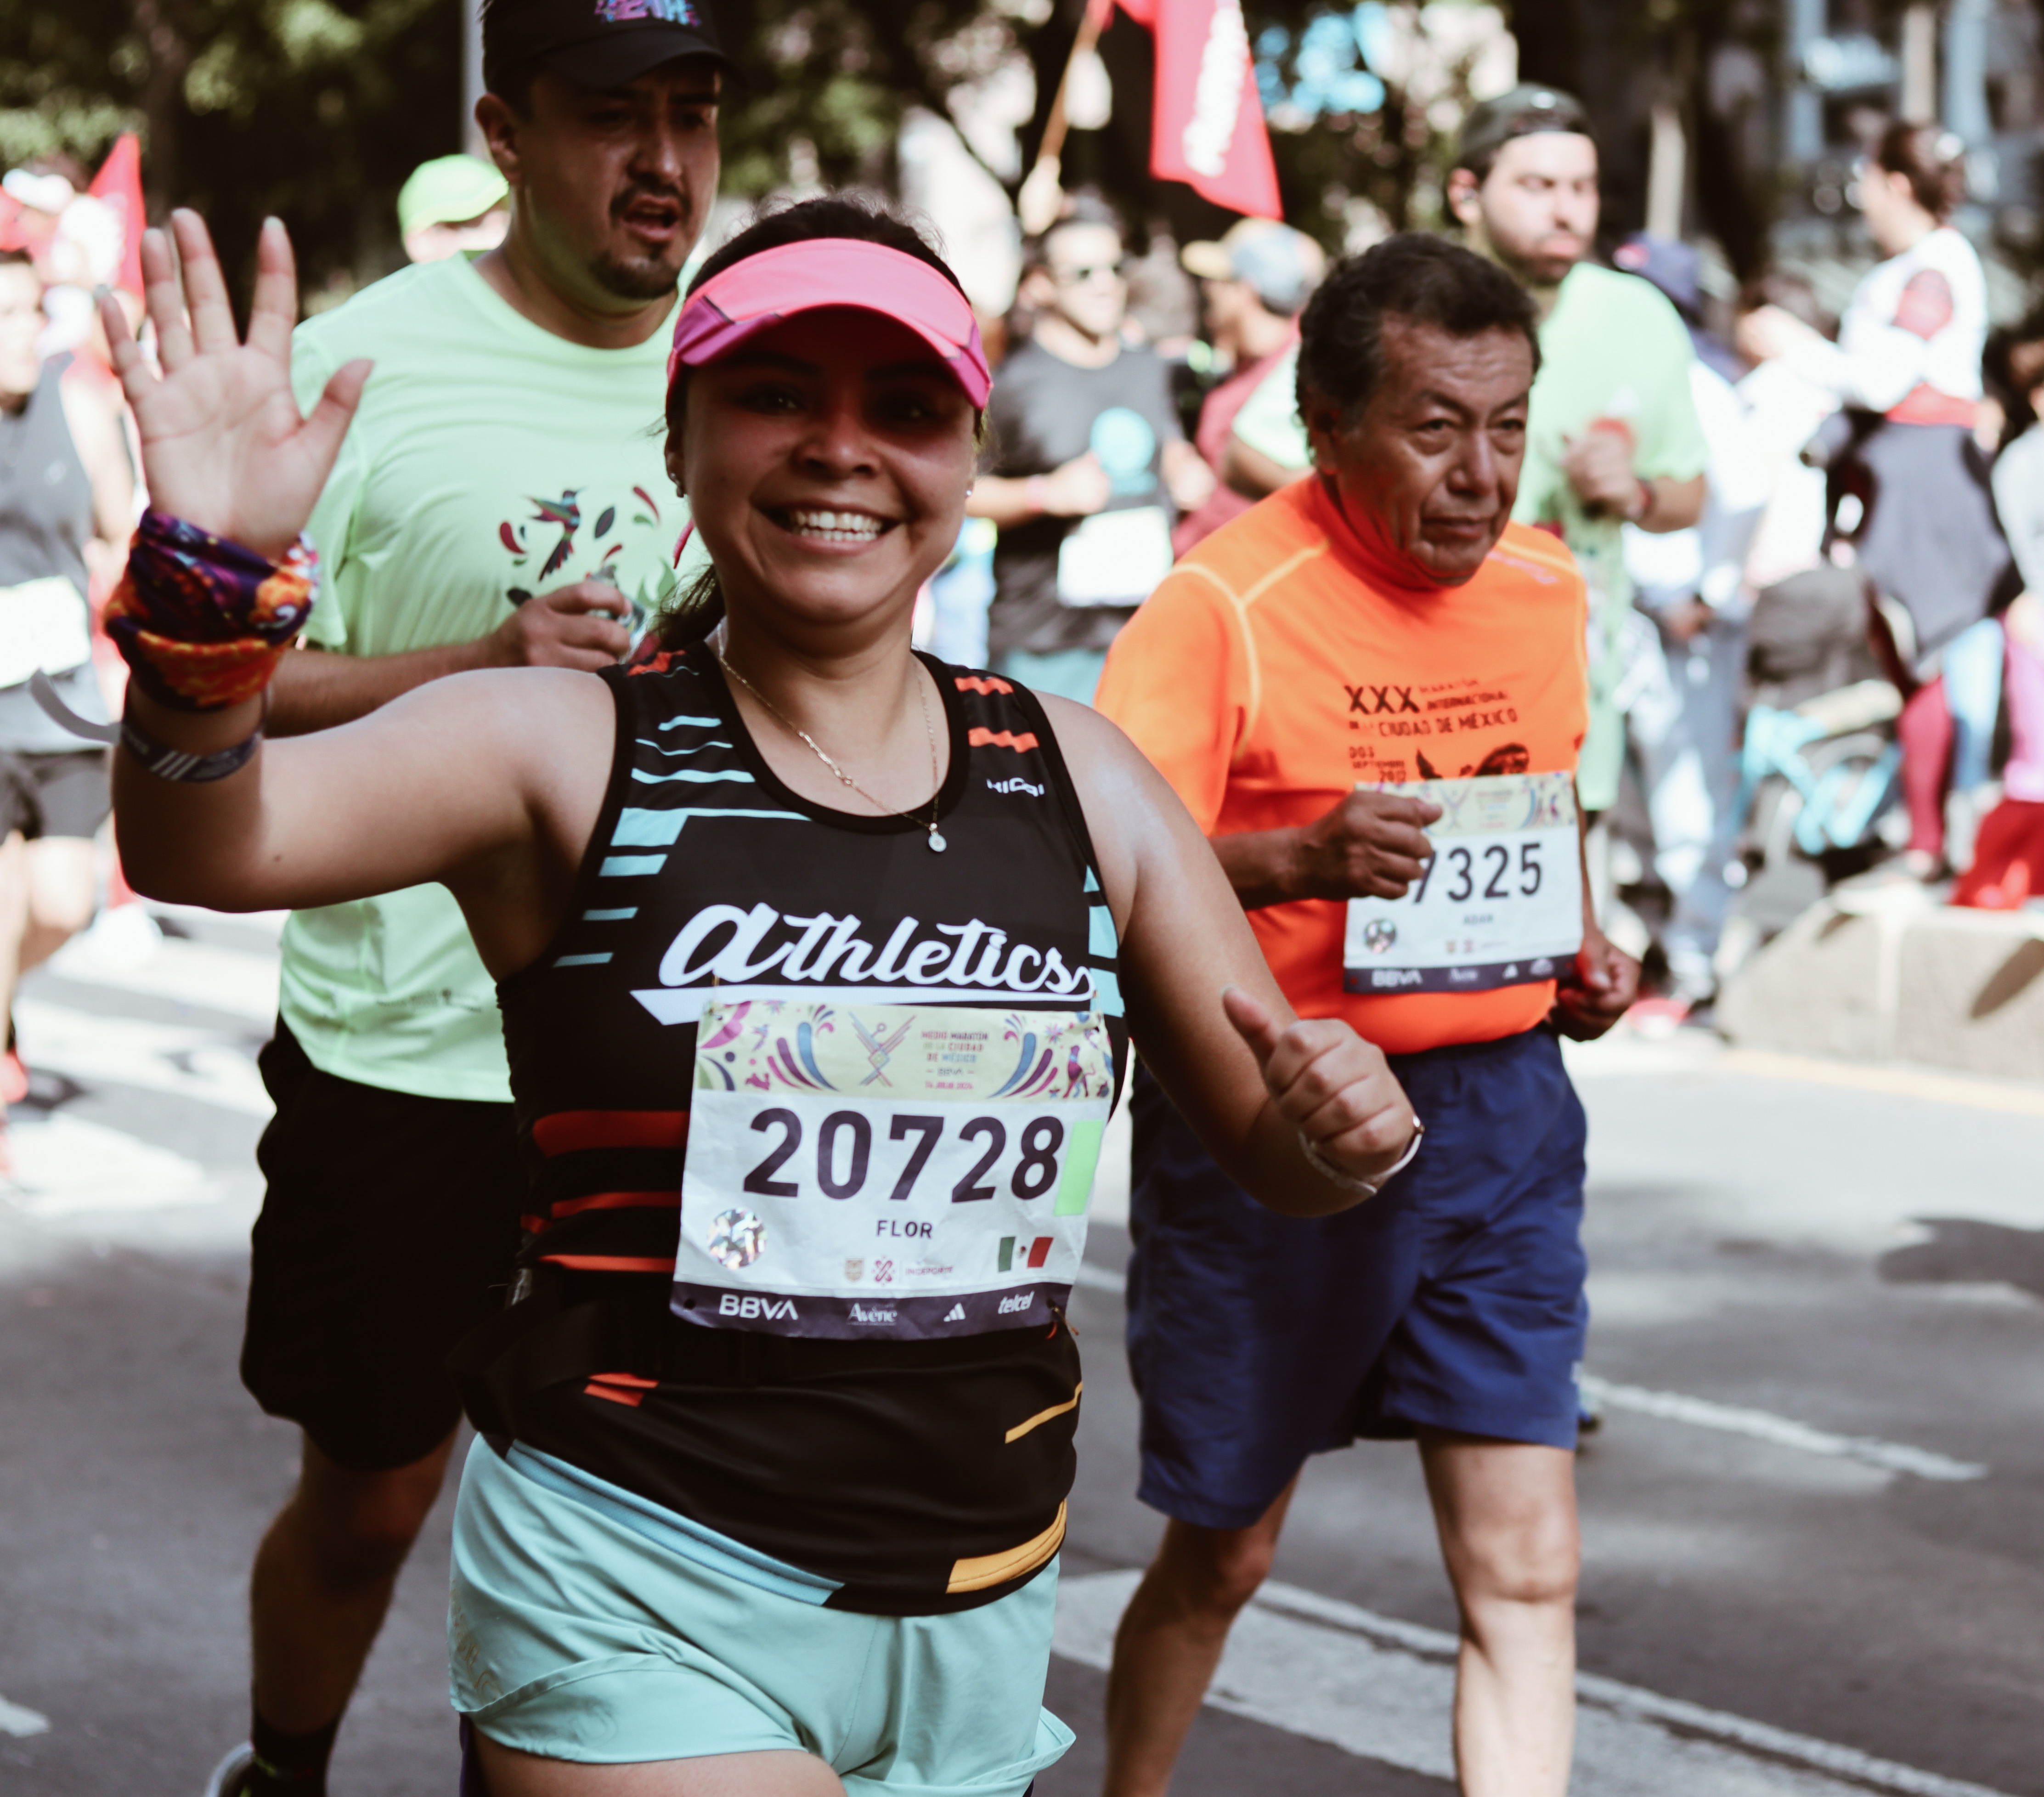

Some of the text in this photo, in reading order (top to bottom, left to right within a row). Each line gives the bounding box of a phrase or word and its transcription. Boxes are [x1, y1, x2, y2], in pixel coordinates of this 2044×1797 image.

[1344, 685, 1420, 715] XXX
[1379, 720, 1431, 737] CIUDAD
[1435, 717, 1453, 734] DE
[1372, 969, 1423, 988] BBVA
[743, 1107, 1064, 1203] 20728
[877, 1220, 932, 1239] FLOR
[719, 1294, 799, 1320] BBVA
[847, 1302, 898, 1322] Avène
[998, 1290, 1035, 1314] telcel
